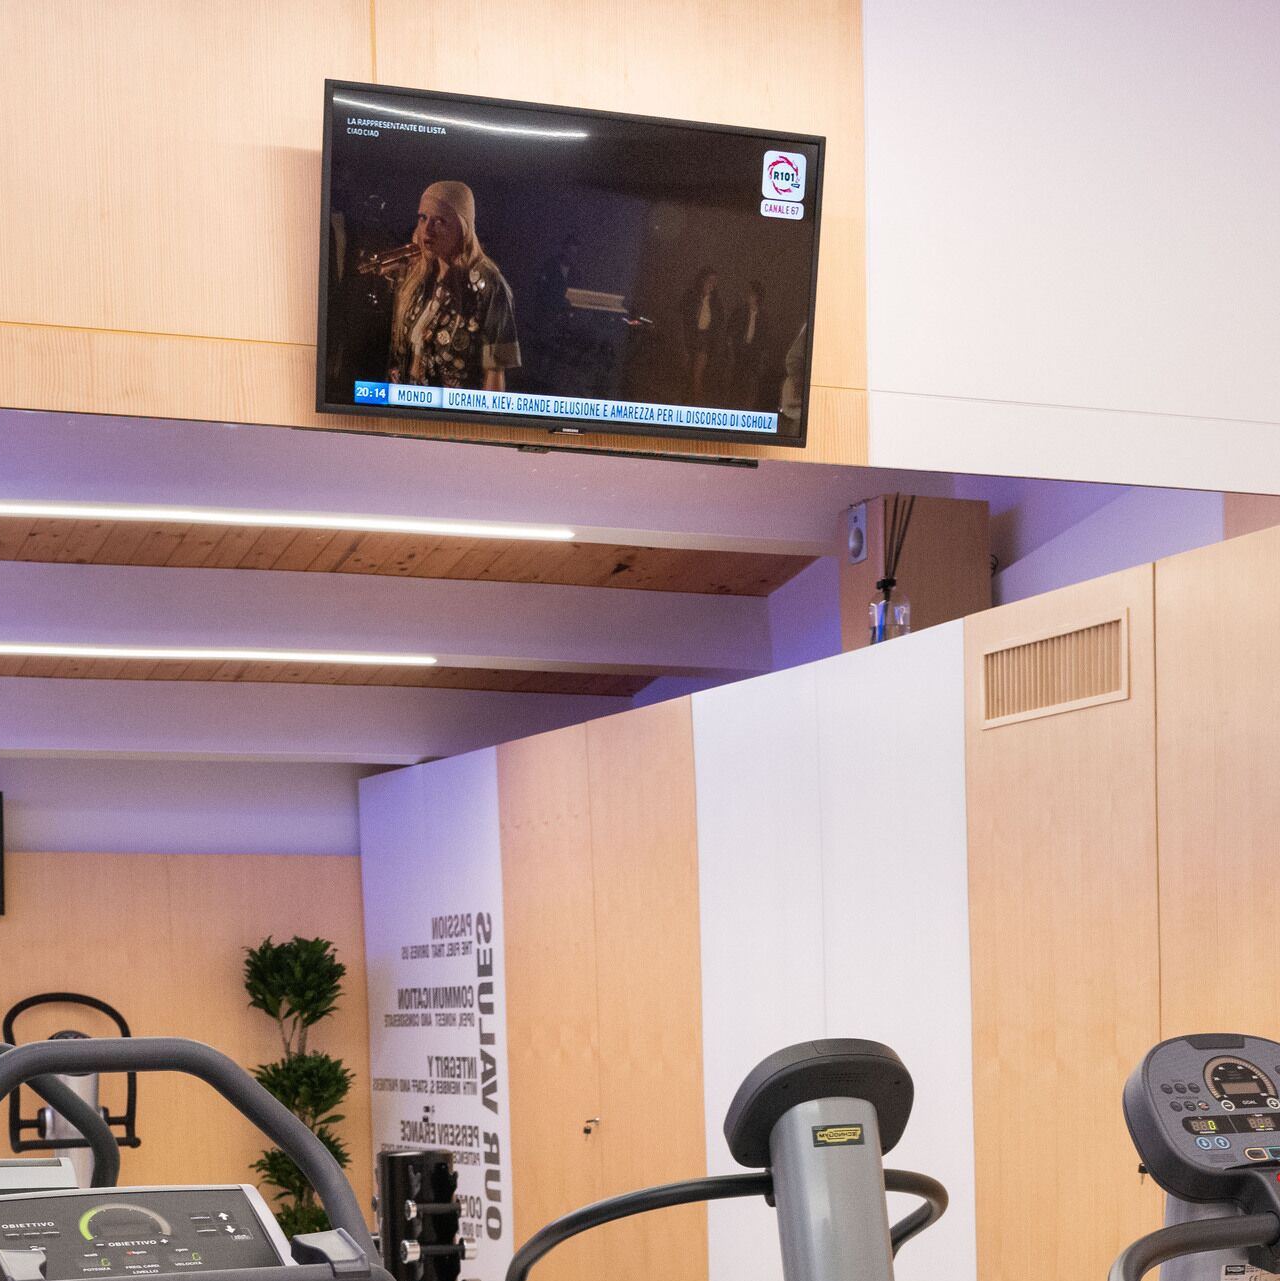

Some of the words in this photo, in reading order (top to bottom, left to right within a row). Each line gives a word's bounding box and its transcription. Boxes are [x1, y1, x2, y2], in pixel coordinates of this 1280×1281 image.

[347, 127, 362, 136] CIAO
[363, 129, 379, 137] CIAO
[358, 119, 417, 130] RAPPRESENTANTE
[418, 125, 426, 133] DI
[427, 126, 447, 135] LISTA
[773, 171, 795, 181] R101
[764, 203, 790, 215] CANALE
[791, 206, 799, 215] 67
[356, 386, 386, 398] 20:14
[398, 390, 433, 403] MONDO
[448, 394, 490, 409] UCRAINA,
[492, 396, 515, 410] KIEV:
[516, 399, 551, 413] GRANDE
[553, 401, 600, 417] DELUSIONE
[603, 404, 608, 417] E
[611, 405, 654, 421] AMAREZZA
[656, 408, 674, 422] PER
[676, 410, 684, 423] IL
[686, 411, 728, 426] DISCORSO
[730, 414, 739, 427] DI
[741, 415, 772, 430] SCHOLZ
[1, 1221, 55, 1229] OBIETTIVO
